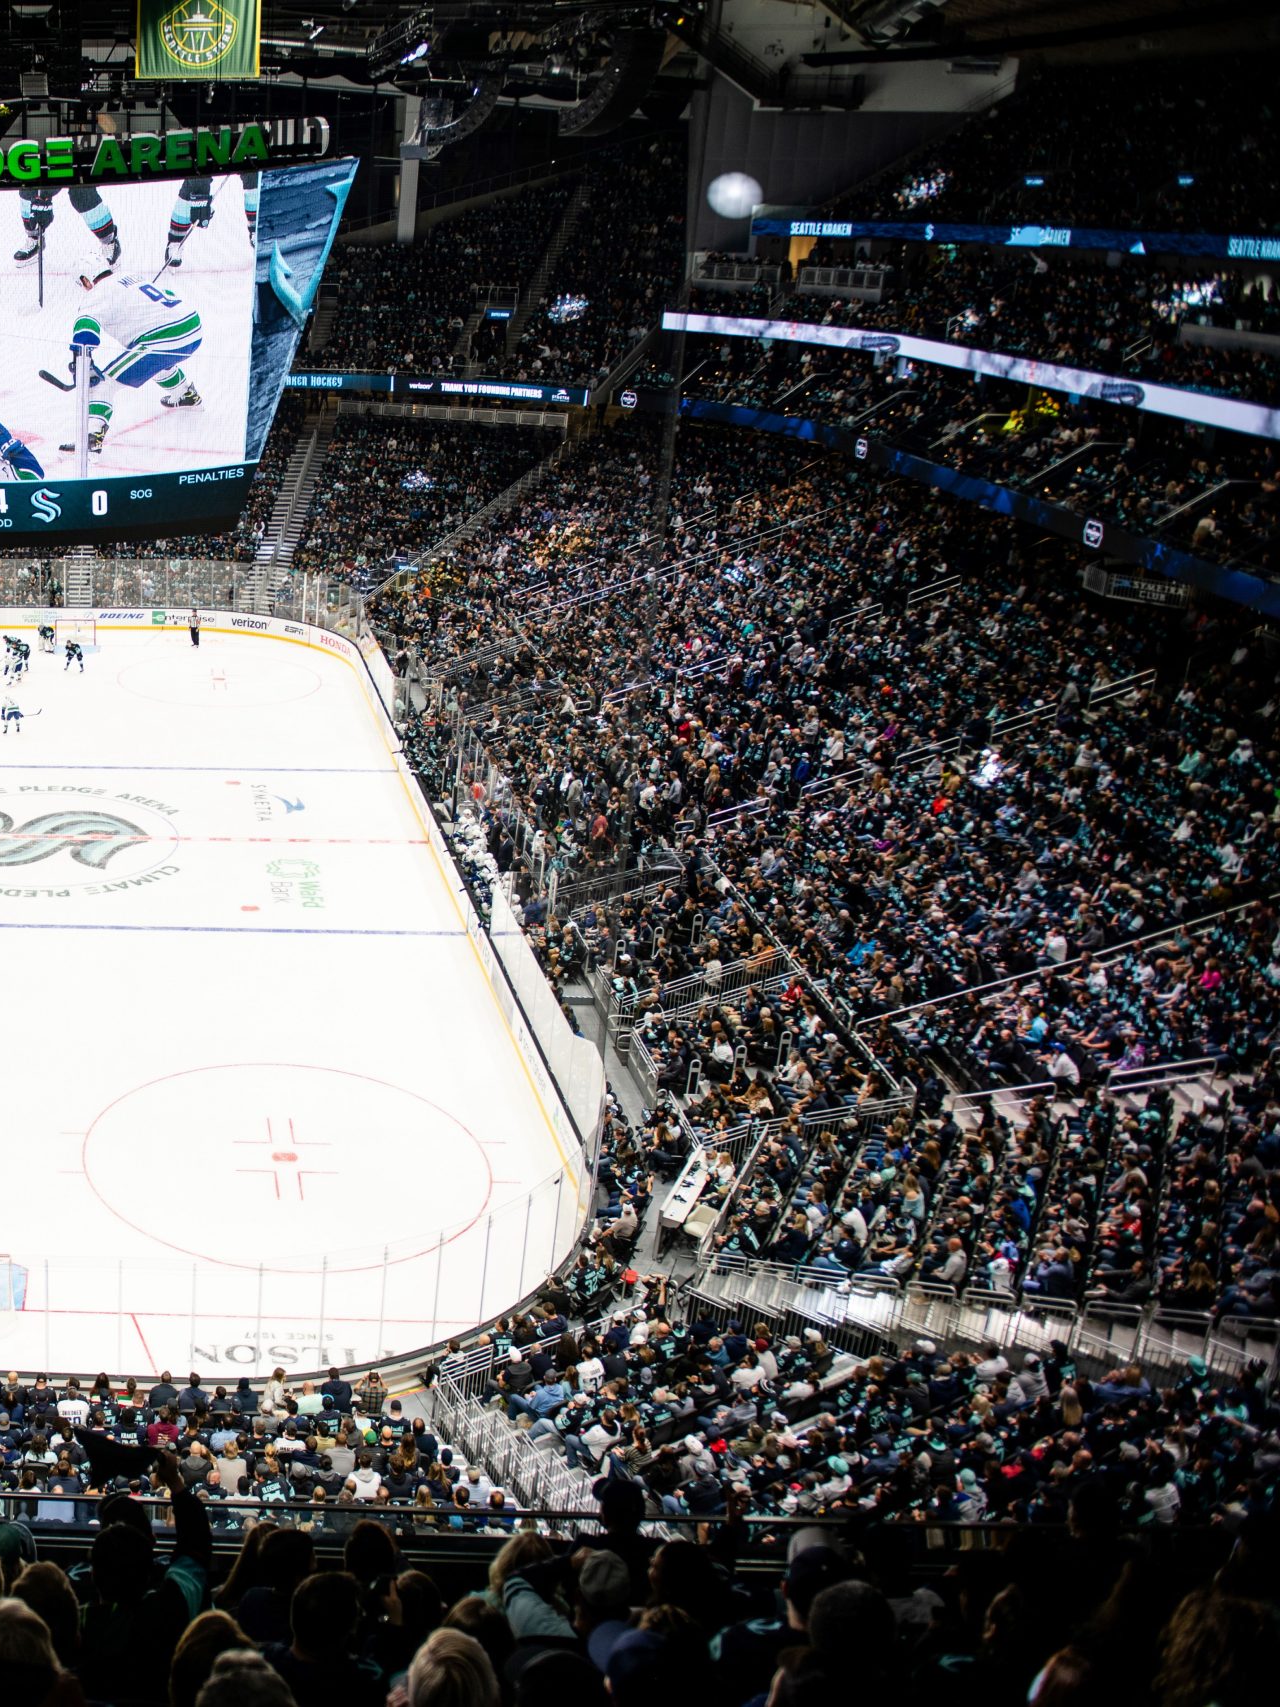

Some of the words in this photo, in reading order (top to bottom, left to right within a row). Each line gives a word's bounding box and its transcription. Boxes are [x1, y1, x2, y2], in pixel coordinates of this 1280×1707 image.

[164, 23, 201, 63] SEATTLE
[206, 24, 233, 61] STORM
[91, 122, 269, 177] ARENA
[790, 222, 821, 235] SEATTLE
[822, 223, 853, 237] KRAKEN
[1228, 236, 1260, 258] SEATTLE
[285, 375, 308, 386] AKEN
[310, 376, 343, 388] HOCKEY
[441, 382, 463, 393] THANK
[464, 384, 478, 393] YOU
[479, 385, 510, 396] FOUNDING
[511, 388, 543, 399] PARTNERS
[179, 467, 245, 485] PENALTIES
[91, 490, 108, 516] 0
[130, 488, 153, 500] SOG
[1133, 581, 1185, 596] SYMETRA
[1139, 590, 1166, 601] CLUB
[154, 612, 216, 623] enterpise
[231, 617, 268, 630] verizon
[284, 625, 305, 636] ESPN
[320, 635, 352, 657] HONDA
[19, 785, 108, 796] PLEDGE
[115, 792, 181, 816] ARENA
[250, 784, 272, 822] SYMETRA
[84, 865, 182, 895] CLIMATE
[298, 880, 326, 909] WaFd
